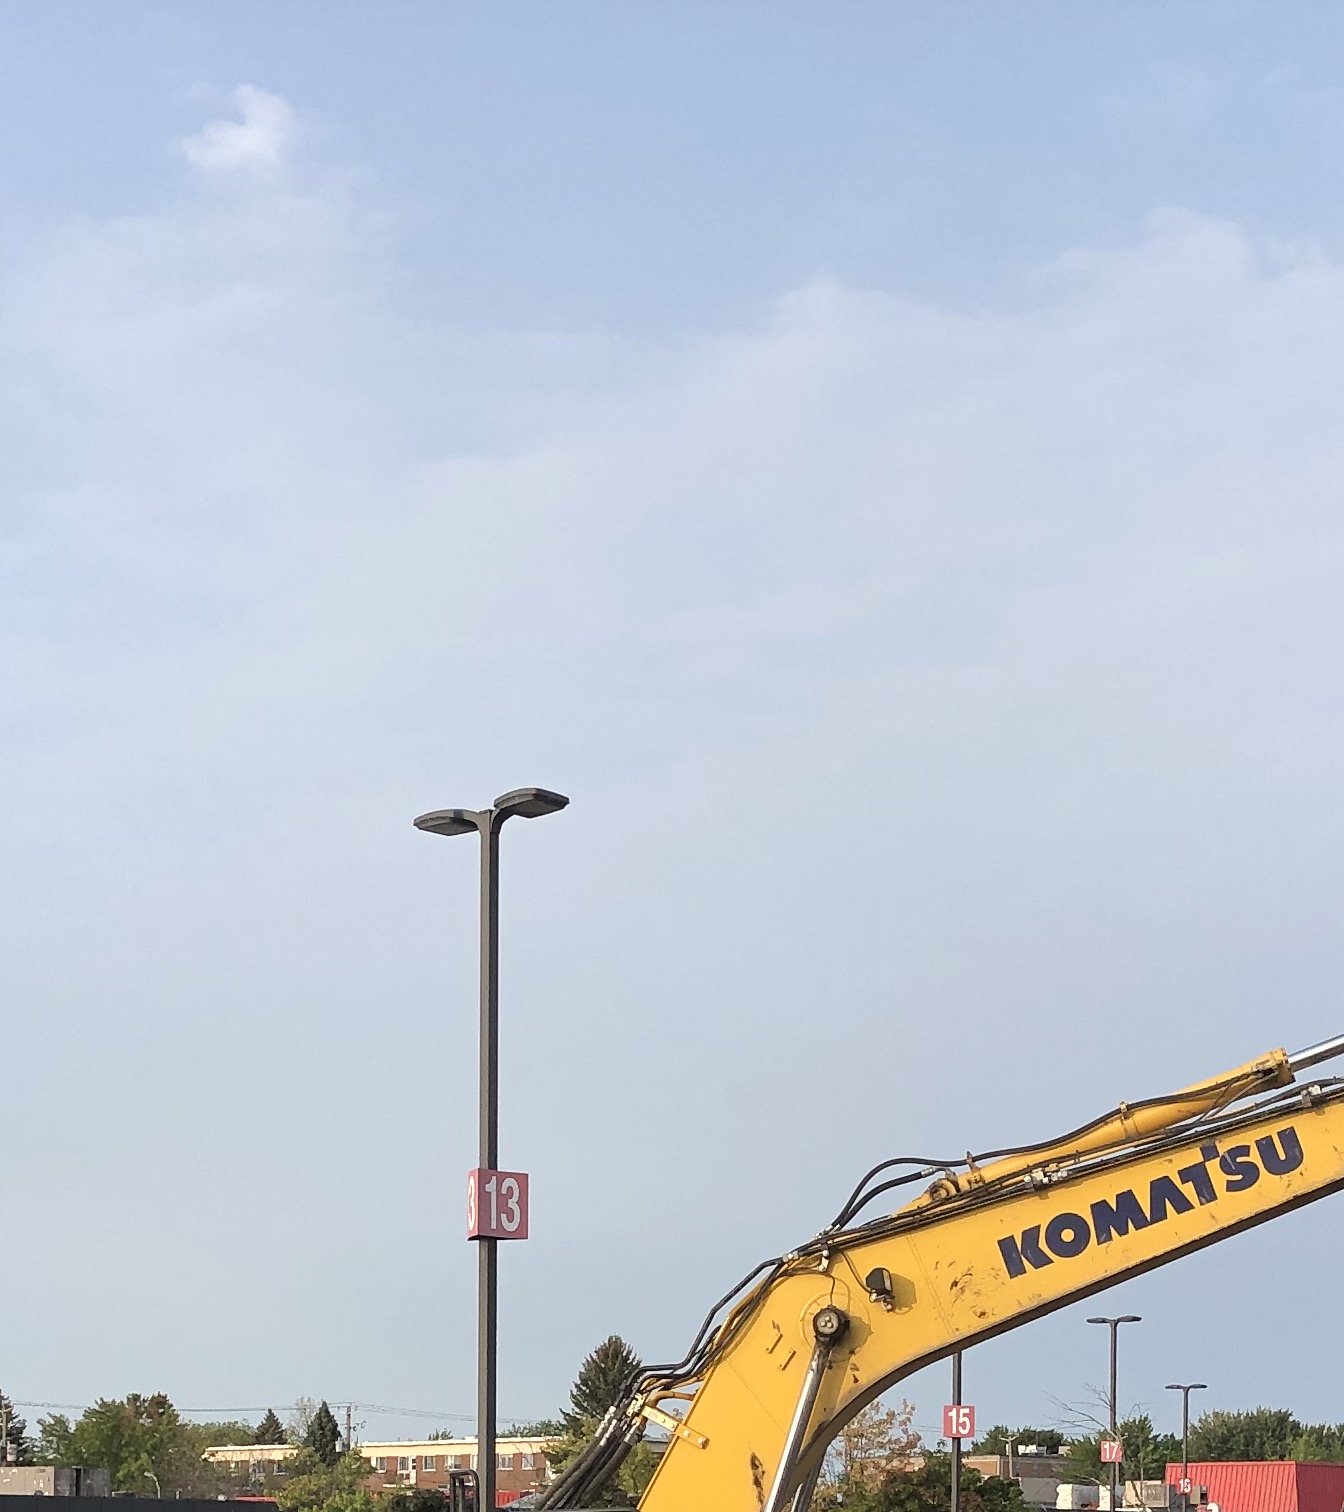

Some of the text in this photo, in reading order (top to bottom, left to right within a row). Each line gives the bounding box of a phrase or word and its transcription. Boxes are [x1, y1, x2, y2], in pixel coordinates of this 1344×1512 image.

[484, 1175, 521, 1232] 13
[997, 1126, 1304, 1279] KOMATSU
[947, 1407, 971, 1435] 15
[1103, 1441, 1119, 1460] 17
